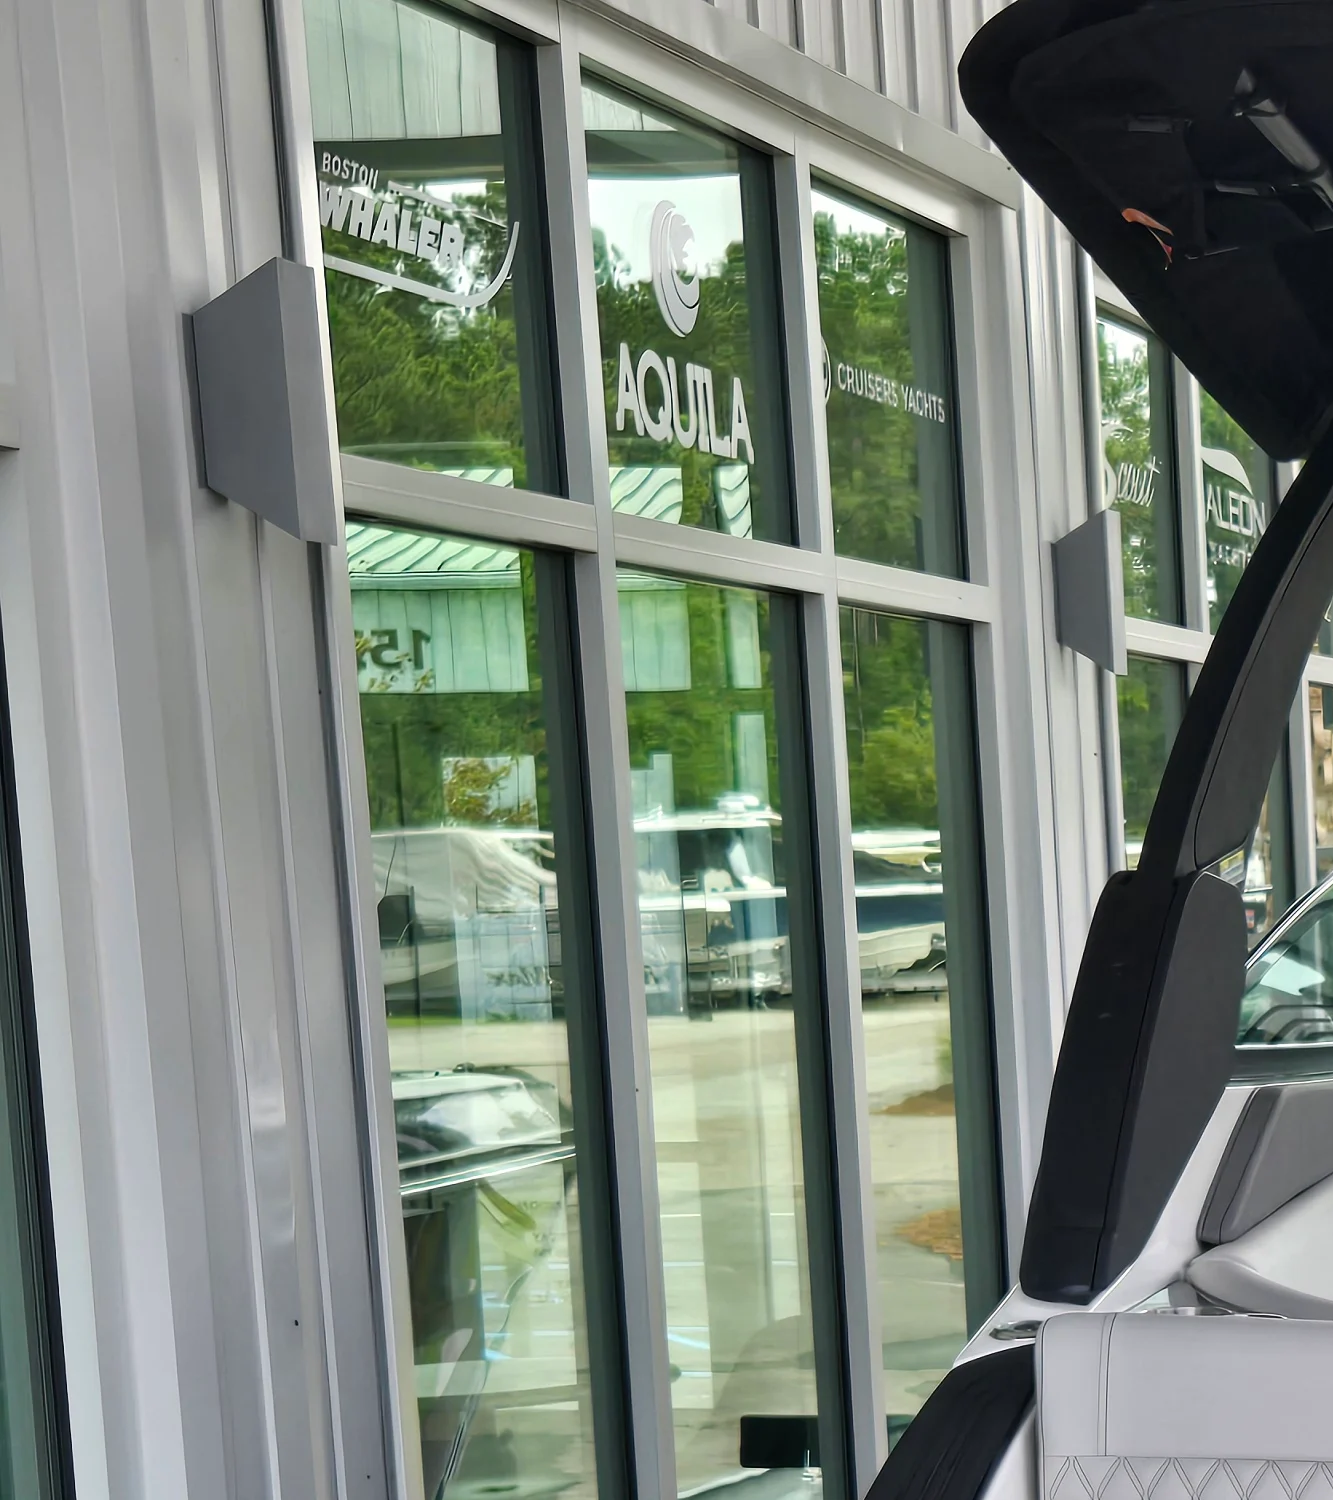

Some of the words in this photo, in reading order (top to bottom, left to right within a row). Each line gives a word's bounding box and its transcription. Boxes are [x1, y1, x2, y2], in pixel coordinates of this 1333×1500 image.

[322, 152, 379, 189] BOSTON
[319, 181, 466, 266] WHALER
[616, 342, 755, 465] AQUILA
[837, 362, 898, 408] CRUISERS
[900, 384, 946, 424] YACHTS
[1204, 483, 1268, 537] ALEON
